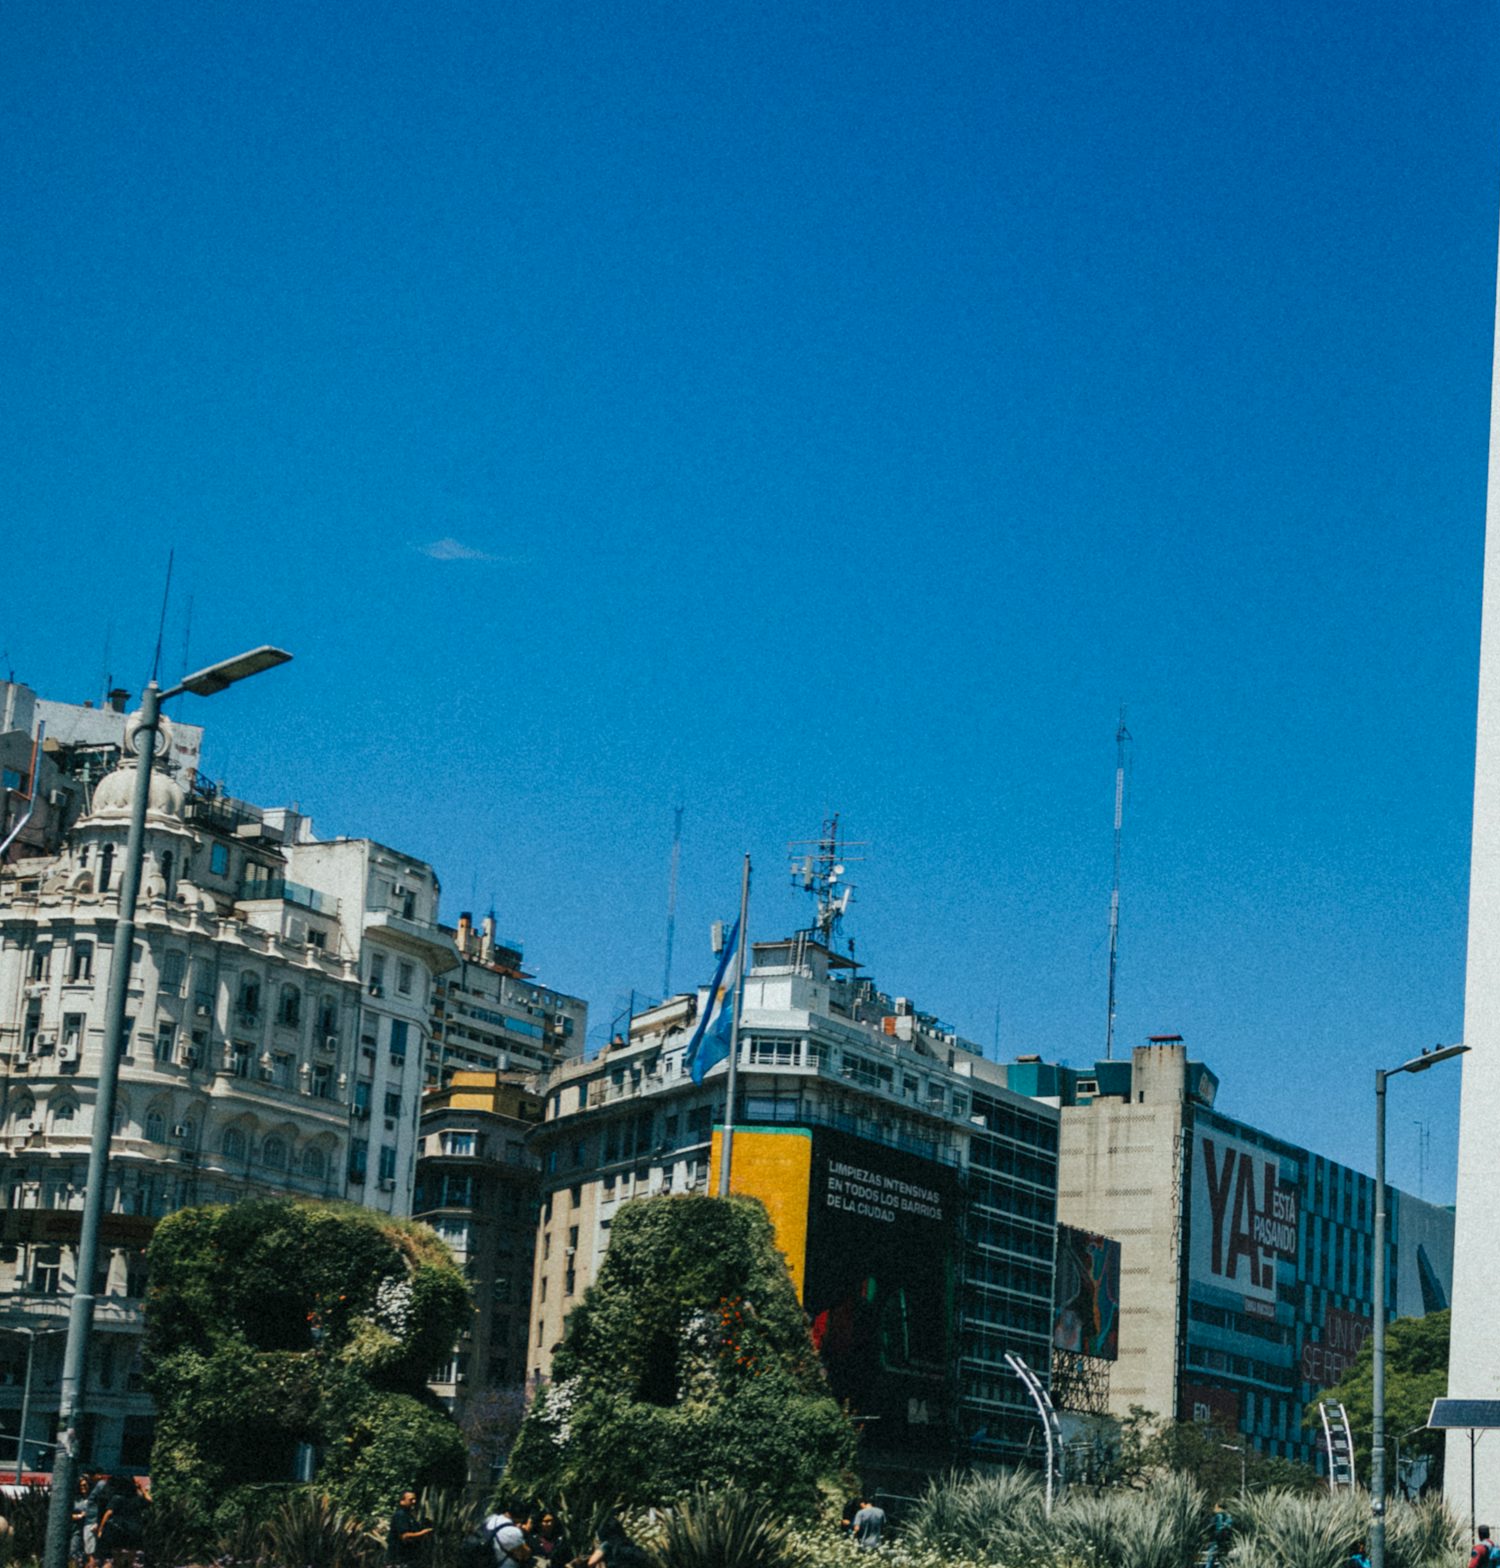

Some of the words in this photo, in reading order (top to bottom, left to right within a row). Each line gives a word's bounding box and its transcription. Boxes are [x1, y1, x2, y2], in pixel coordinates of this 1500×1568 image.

[828, 1160, 882, 1187] LIMPIEZAS
[883, 1177, 940, 1204] INTENSIVAS
[828, 1177, 842, 1192] EN
[844, 1181, 879, 1202] TODOS
[880, 1193, 899, 1208] LOS
[900, 1198, 943, 1220] BARRIOS
[827, 1193, 841, 1208] DE
[842, 1198, 856, 1212] LA
[857, 1203, 895, 1222] CIUDAD
[1202, 1138, 1276, 1290] YA!
[1272, 1191, 1296, 1225] ESTÁ
[1253, 1214, 1296, 1254] PASANDO
